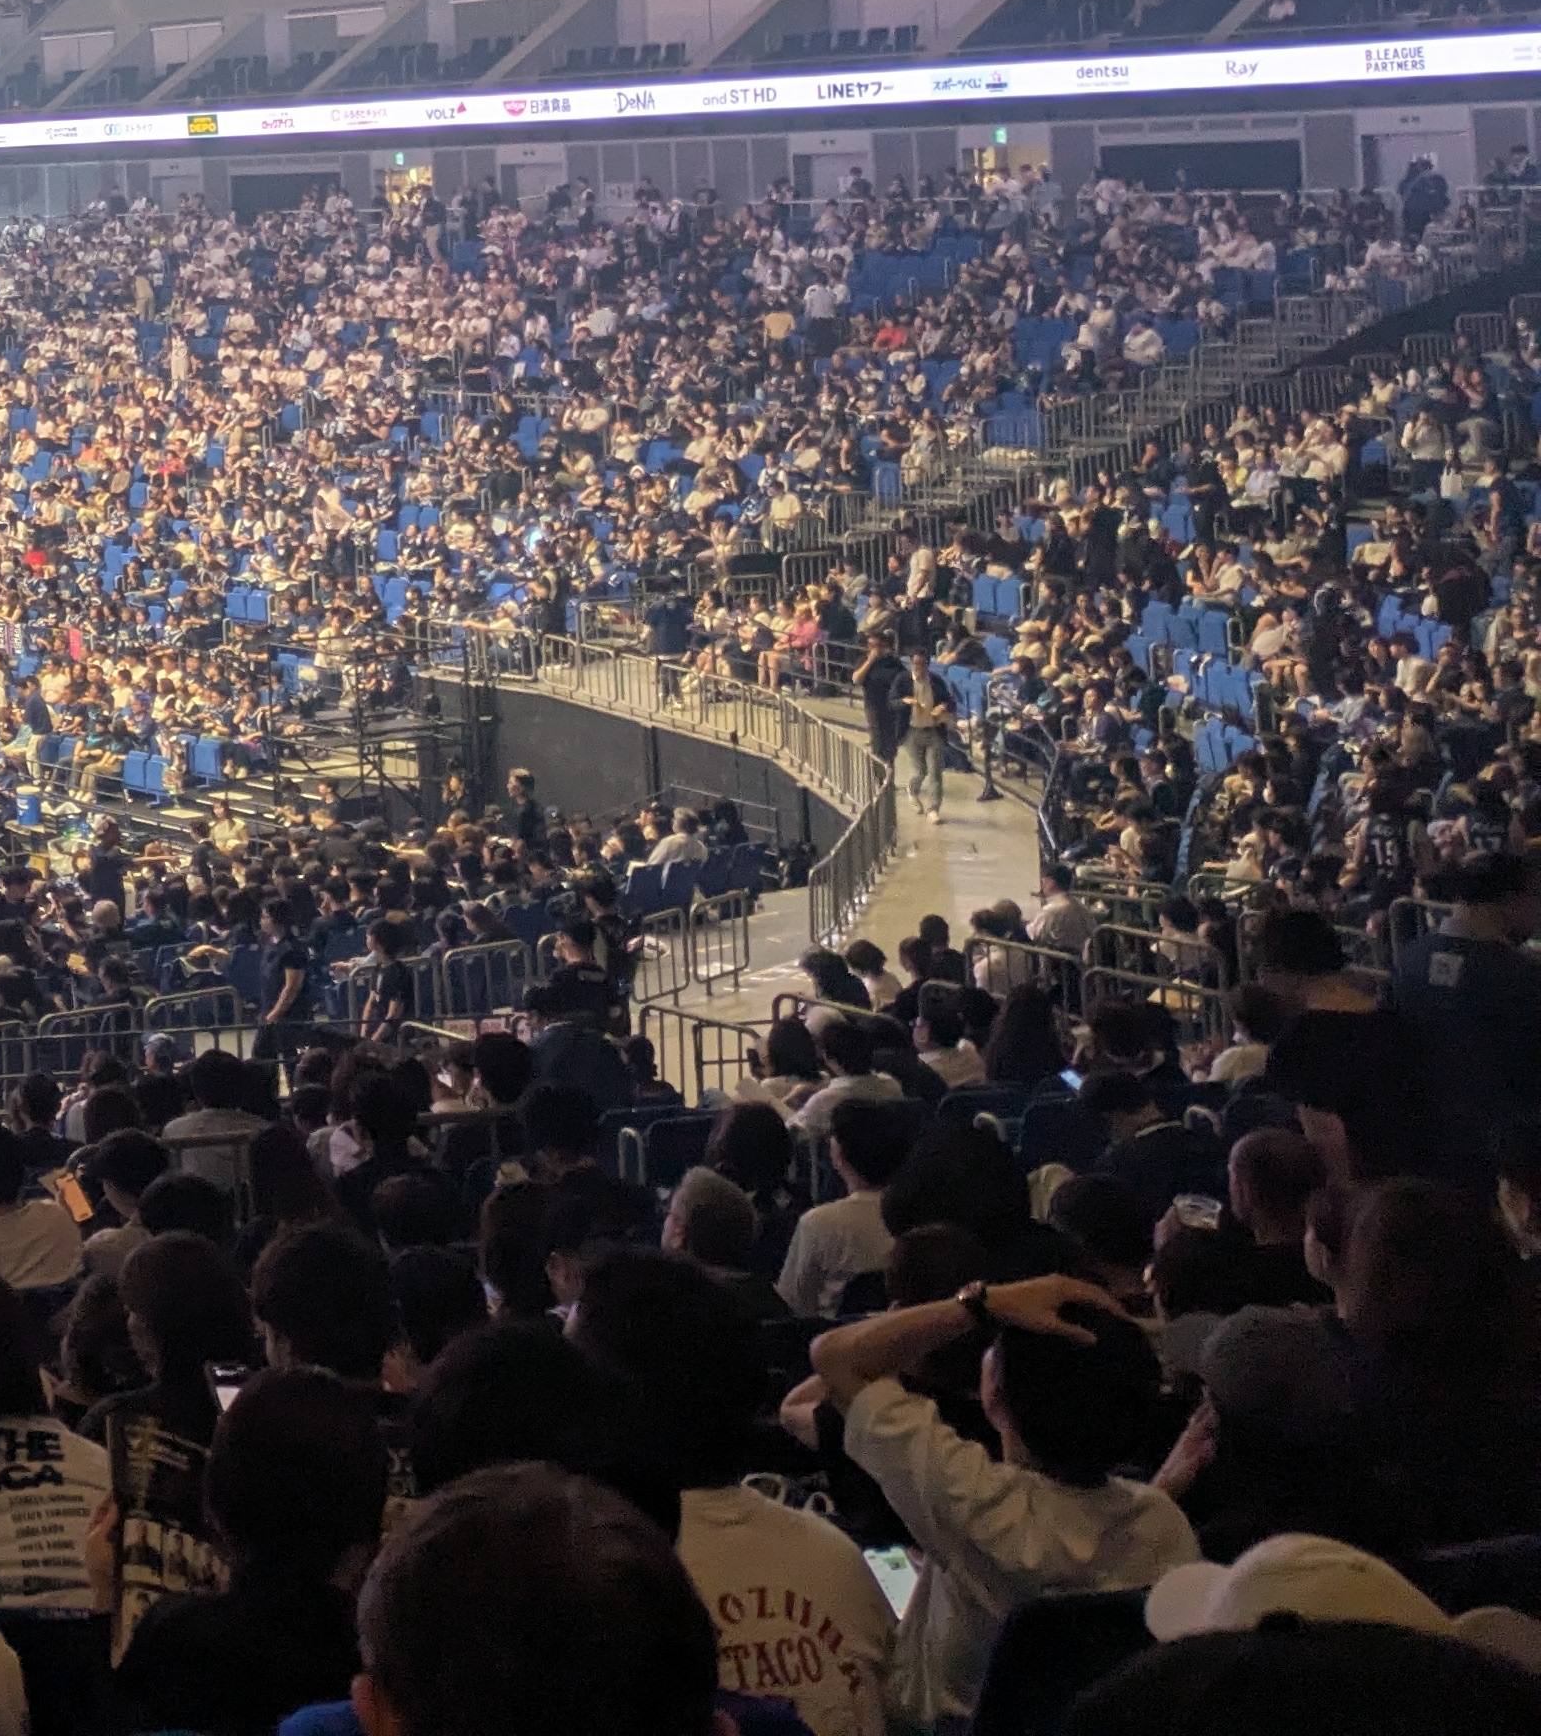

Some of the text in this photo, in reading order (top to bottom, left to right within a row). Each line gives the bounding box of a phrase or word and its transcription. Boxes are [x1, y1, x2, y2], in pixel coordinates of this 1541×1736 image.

[1365, 46, 1424, 62] B.LEAGUE
[1076, 65, 1129, 79] dentsu
[1225, 60, 1260, 77] Ray
[1366, 59, 1425, 73] PARTNERS
[817, 81, 894, 100] LINEヤフー
[933, 77, 982, 91] スポーツくじ
[702, 93, 727, 106] and
[753, 87, 777, 103] HD
[530, 98, 571, 114] 日清食品
[425, 108, 456, 120] VOLZ
[125, 123, 153, 133] ストライク
[189, 123, 217, 133] DEPO
[721, 1636, 822, 1689] TACO
